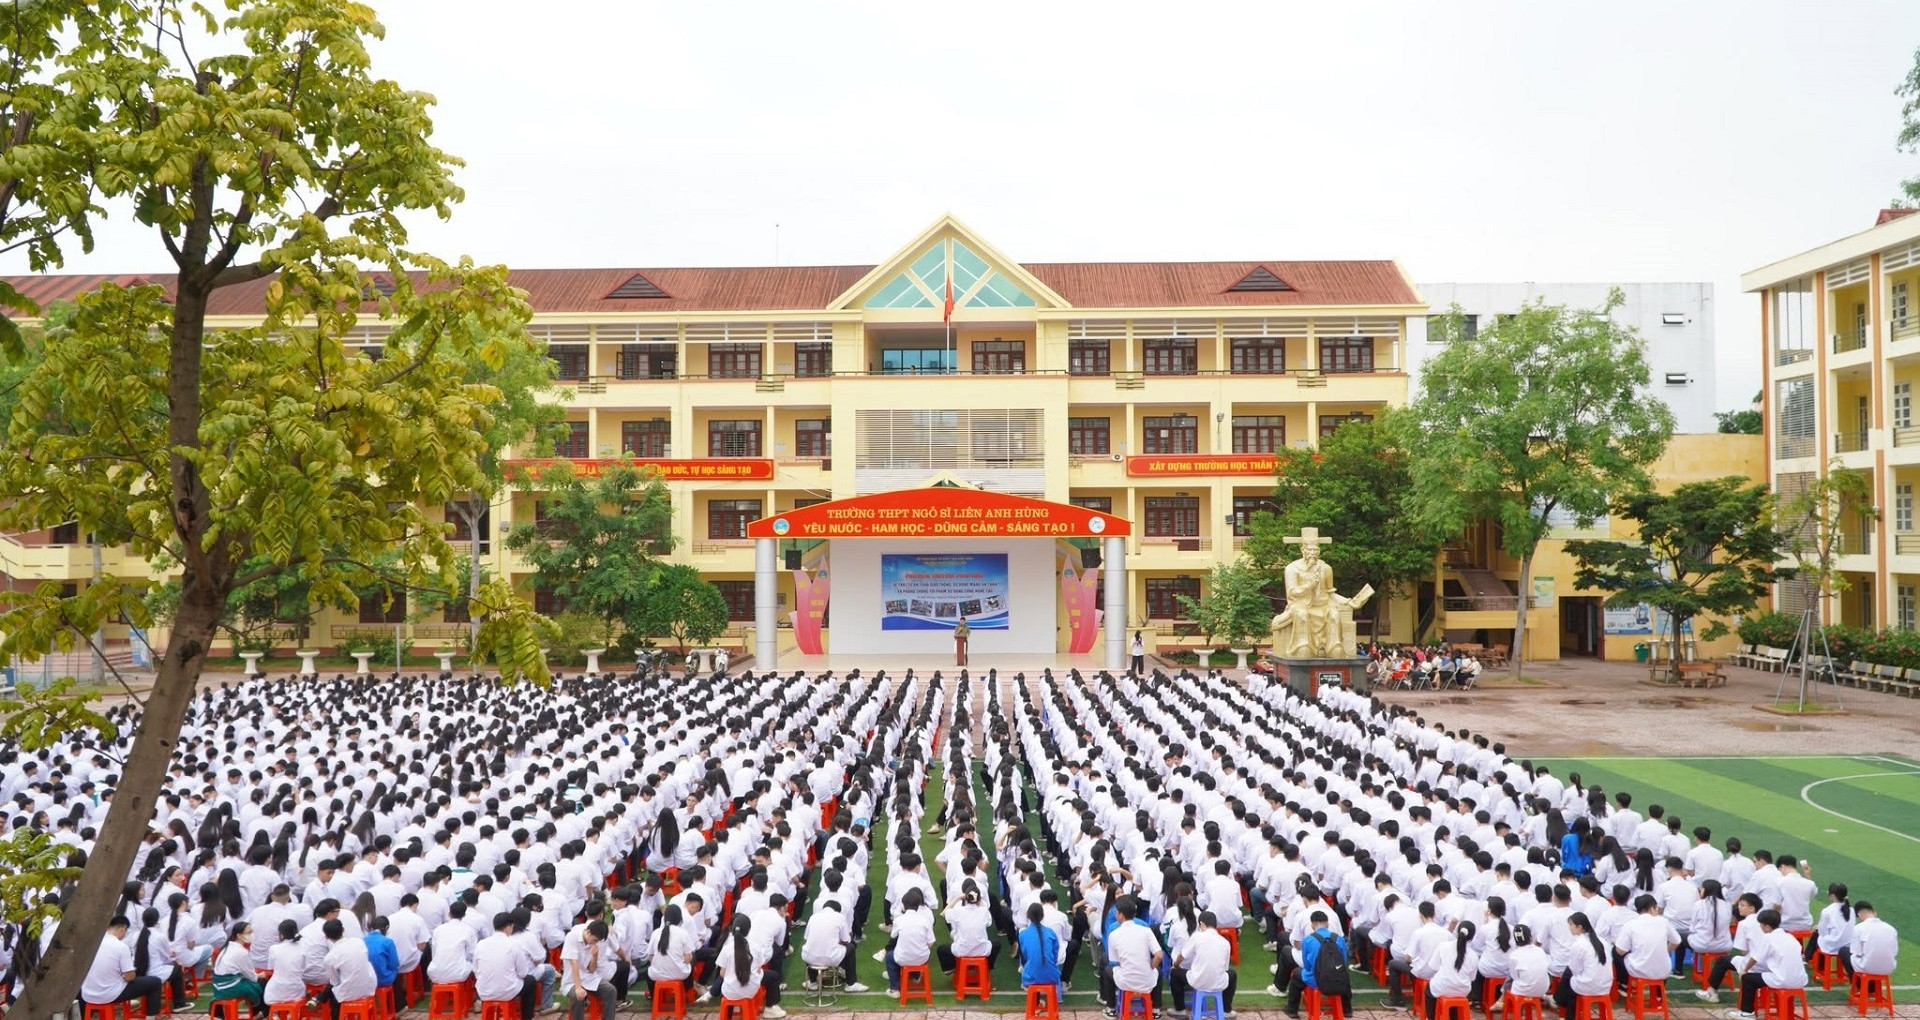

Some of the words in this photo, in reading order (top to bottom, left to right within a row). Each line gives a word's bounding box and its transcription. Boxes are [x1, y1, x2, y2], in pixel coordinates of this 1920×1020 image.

[702, 466, 716, 476] HỌC
[716, 464, 736, 474] SÁNG
[737, 466, 752, 476] TẠO
[1149, 460, 1165, 470] XÂY
[1168, 462, 1192, 472] DỰNG
[1193, 460, 1228, 470] TRƯỜNG
[1230, 461, 1247, 472] HỌC
[1249, 460, 1272, 470] THÂN
[827, 506, 875, 518] TRƯỜNG
[878, 508, 910, 518] THPT
[912, 506, 938, 518] NGÔ
[940, 506, 952, 518] SĨ
[954, 506, 982, 518] LIÊN
[986, 508, 1012, 518] ANH
[1015, 506, 1049, 518] HÙNG
[803, 522, 826, 533] YÊU
[829, 522, 862, 533] NƯỚC
[872, 524, 898, 533] HAM
[900, 524, 925, 535] HỌC
[934, 521, 968, 533] DŨNG
[970, 520, 997, 532] CẢM
[1007, 521, 1040, 532] SÁNG
[1042, 523, 1068, 534] TẠO
